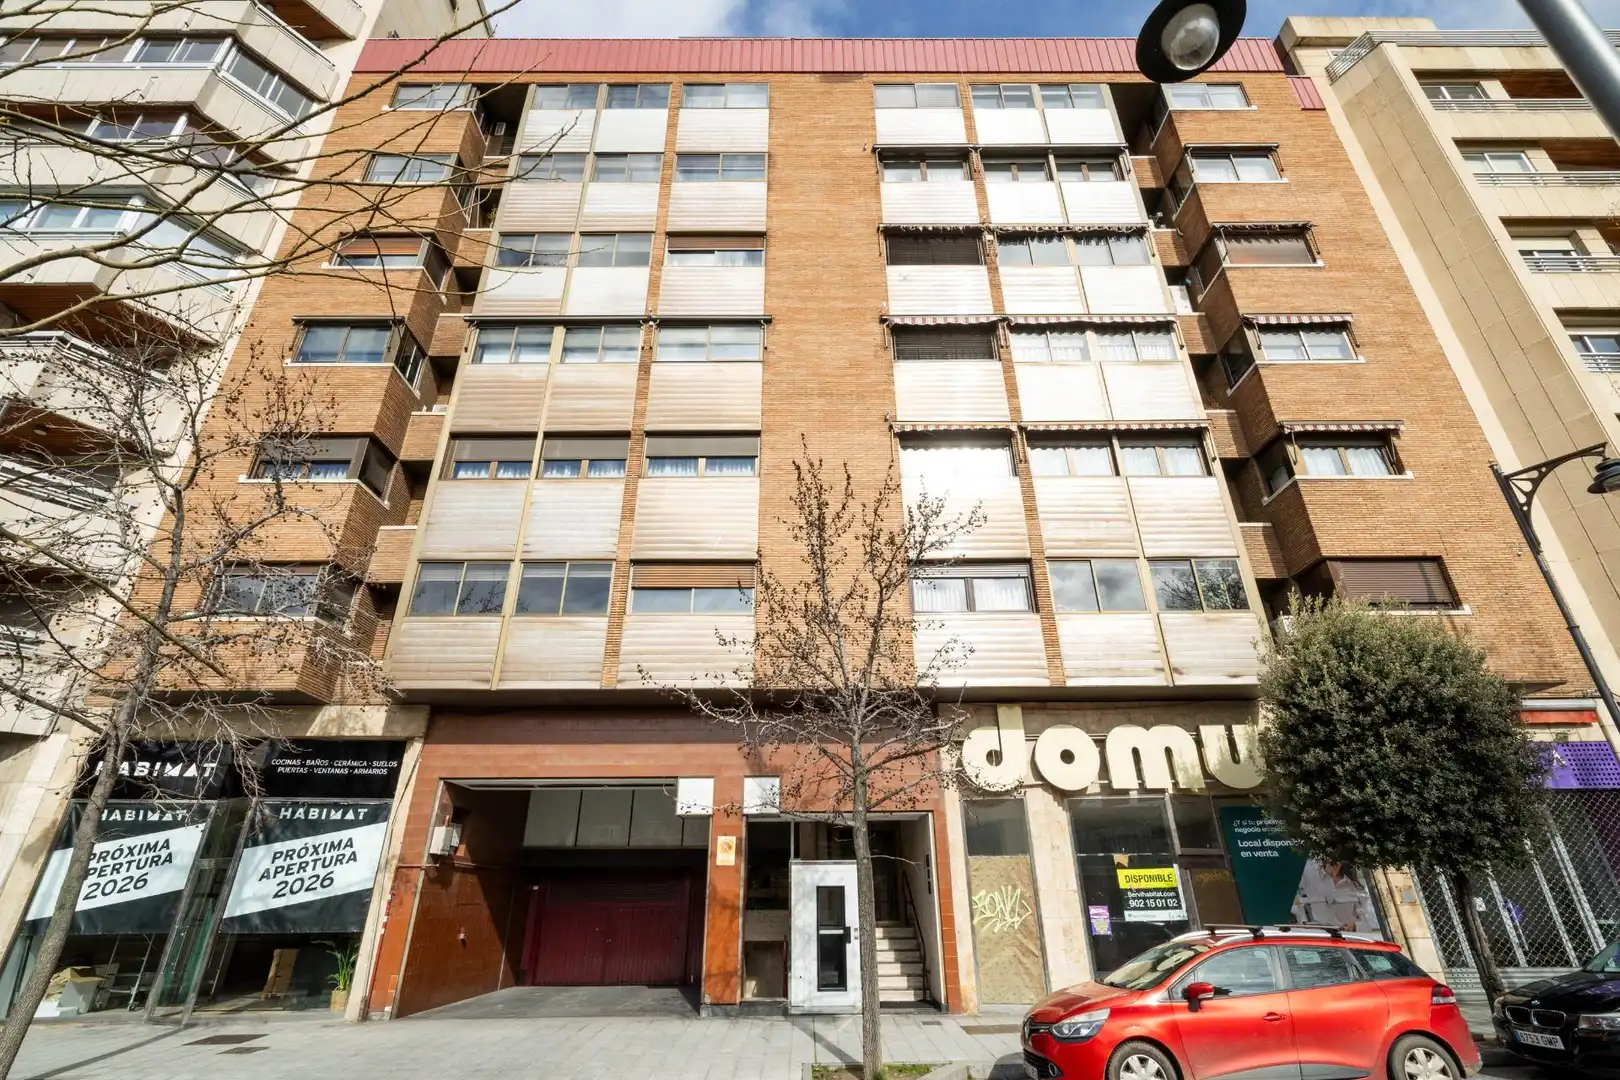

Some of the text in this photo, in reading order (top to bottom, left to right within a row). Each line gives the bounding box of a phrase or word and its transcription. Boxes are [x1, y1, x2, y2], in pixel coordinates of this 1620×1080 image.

[305, 758, 329, 767] BAÑOS
[333, 759, 367, 767] CERÁMICA
[372, 760, 398, 768] SUELOS
[313, 767, 349, 775] VENTANAS
[279, 807, 368, 820] HABIMAT
[1234, 826, 1261, 834] negocio
[1237, 838, 1261, 848] Local
[271, 837, 354, 865] PRÓXIMA
[1253, 849, 1279, 858] venta
[87, 852, 173, 879] PERTURA
[258, 851, 358, 882] APERTURA
[1124, 873, 1173, 884] DISPONIBLE
[82, 872, 149, 901] 2026
[272, 870, 334, 899] 2026
[1129, 898, 1178, 908] 902 15 01 02
